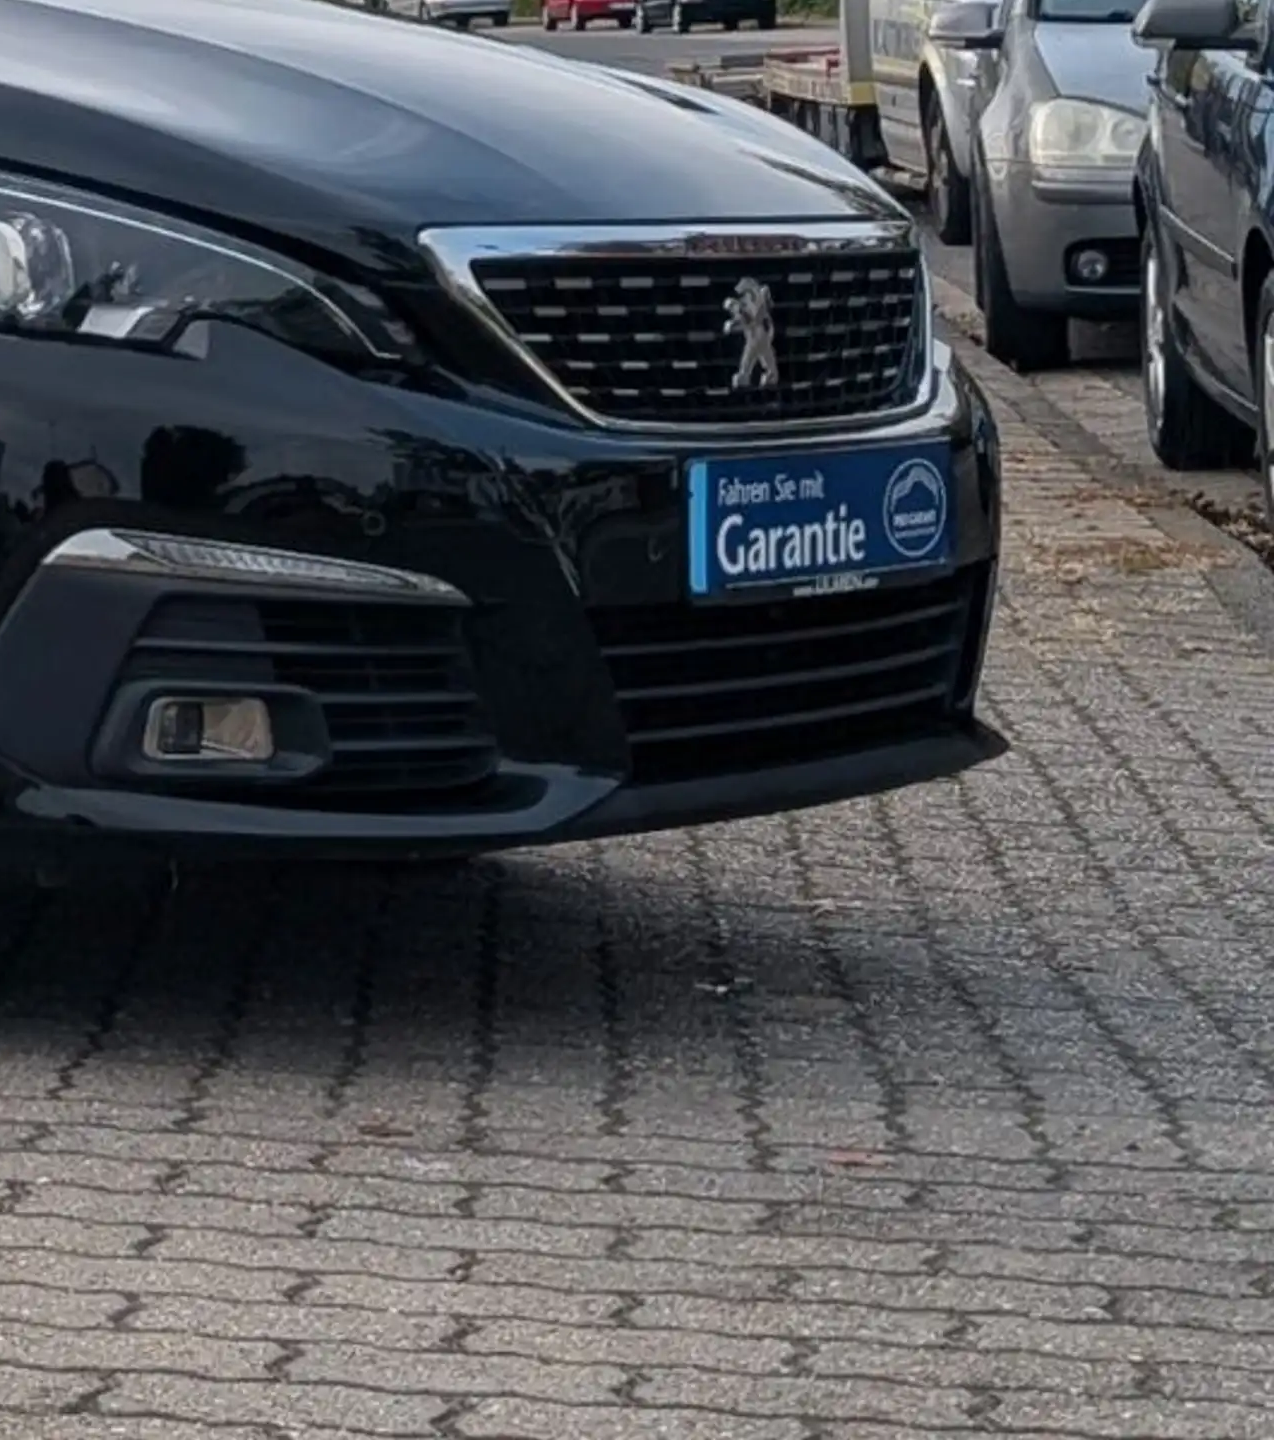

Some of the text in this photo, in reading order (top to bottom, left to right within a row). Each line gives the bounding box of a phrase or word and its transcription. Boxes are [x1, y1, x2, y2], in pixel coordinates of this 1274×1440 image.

[717, 468, 826, 508] Fahren Sie mit
[716, 502, 866, 577] Garantie
